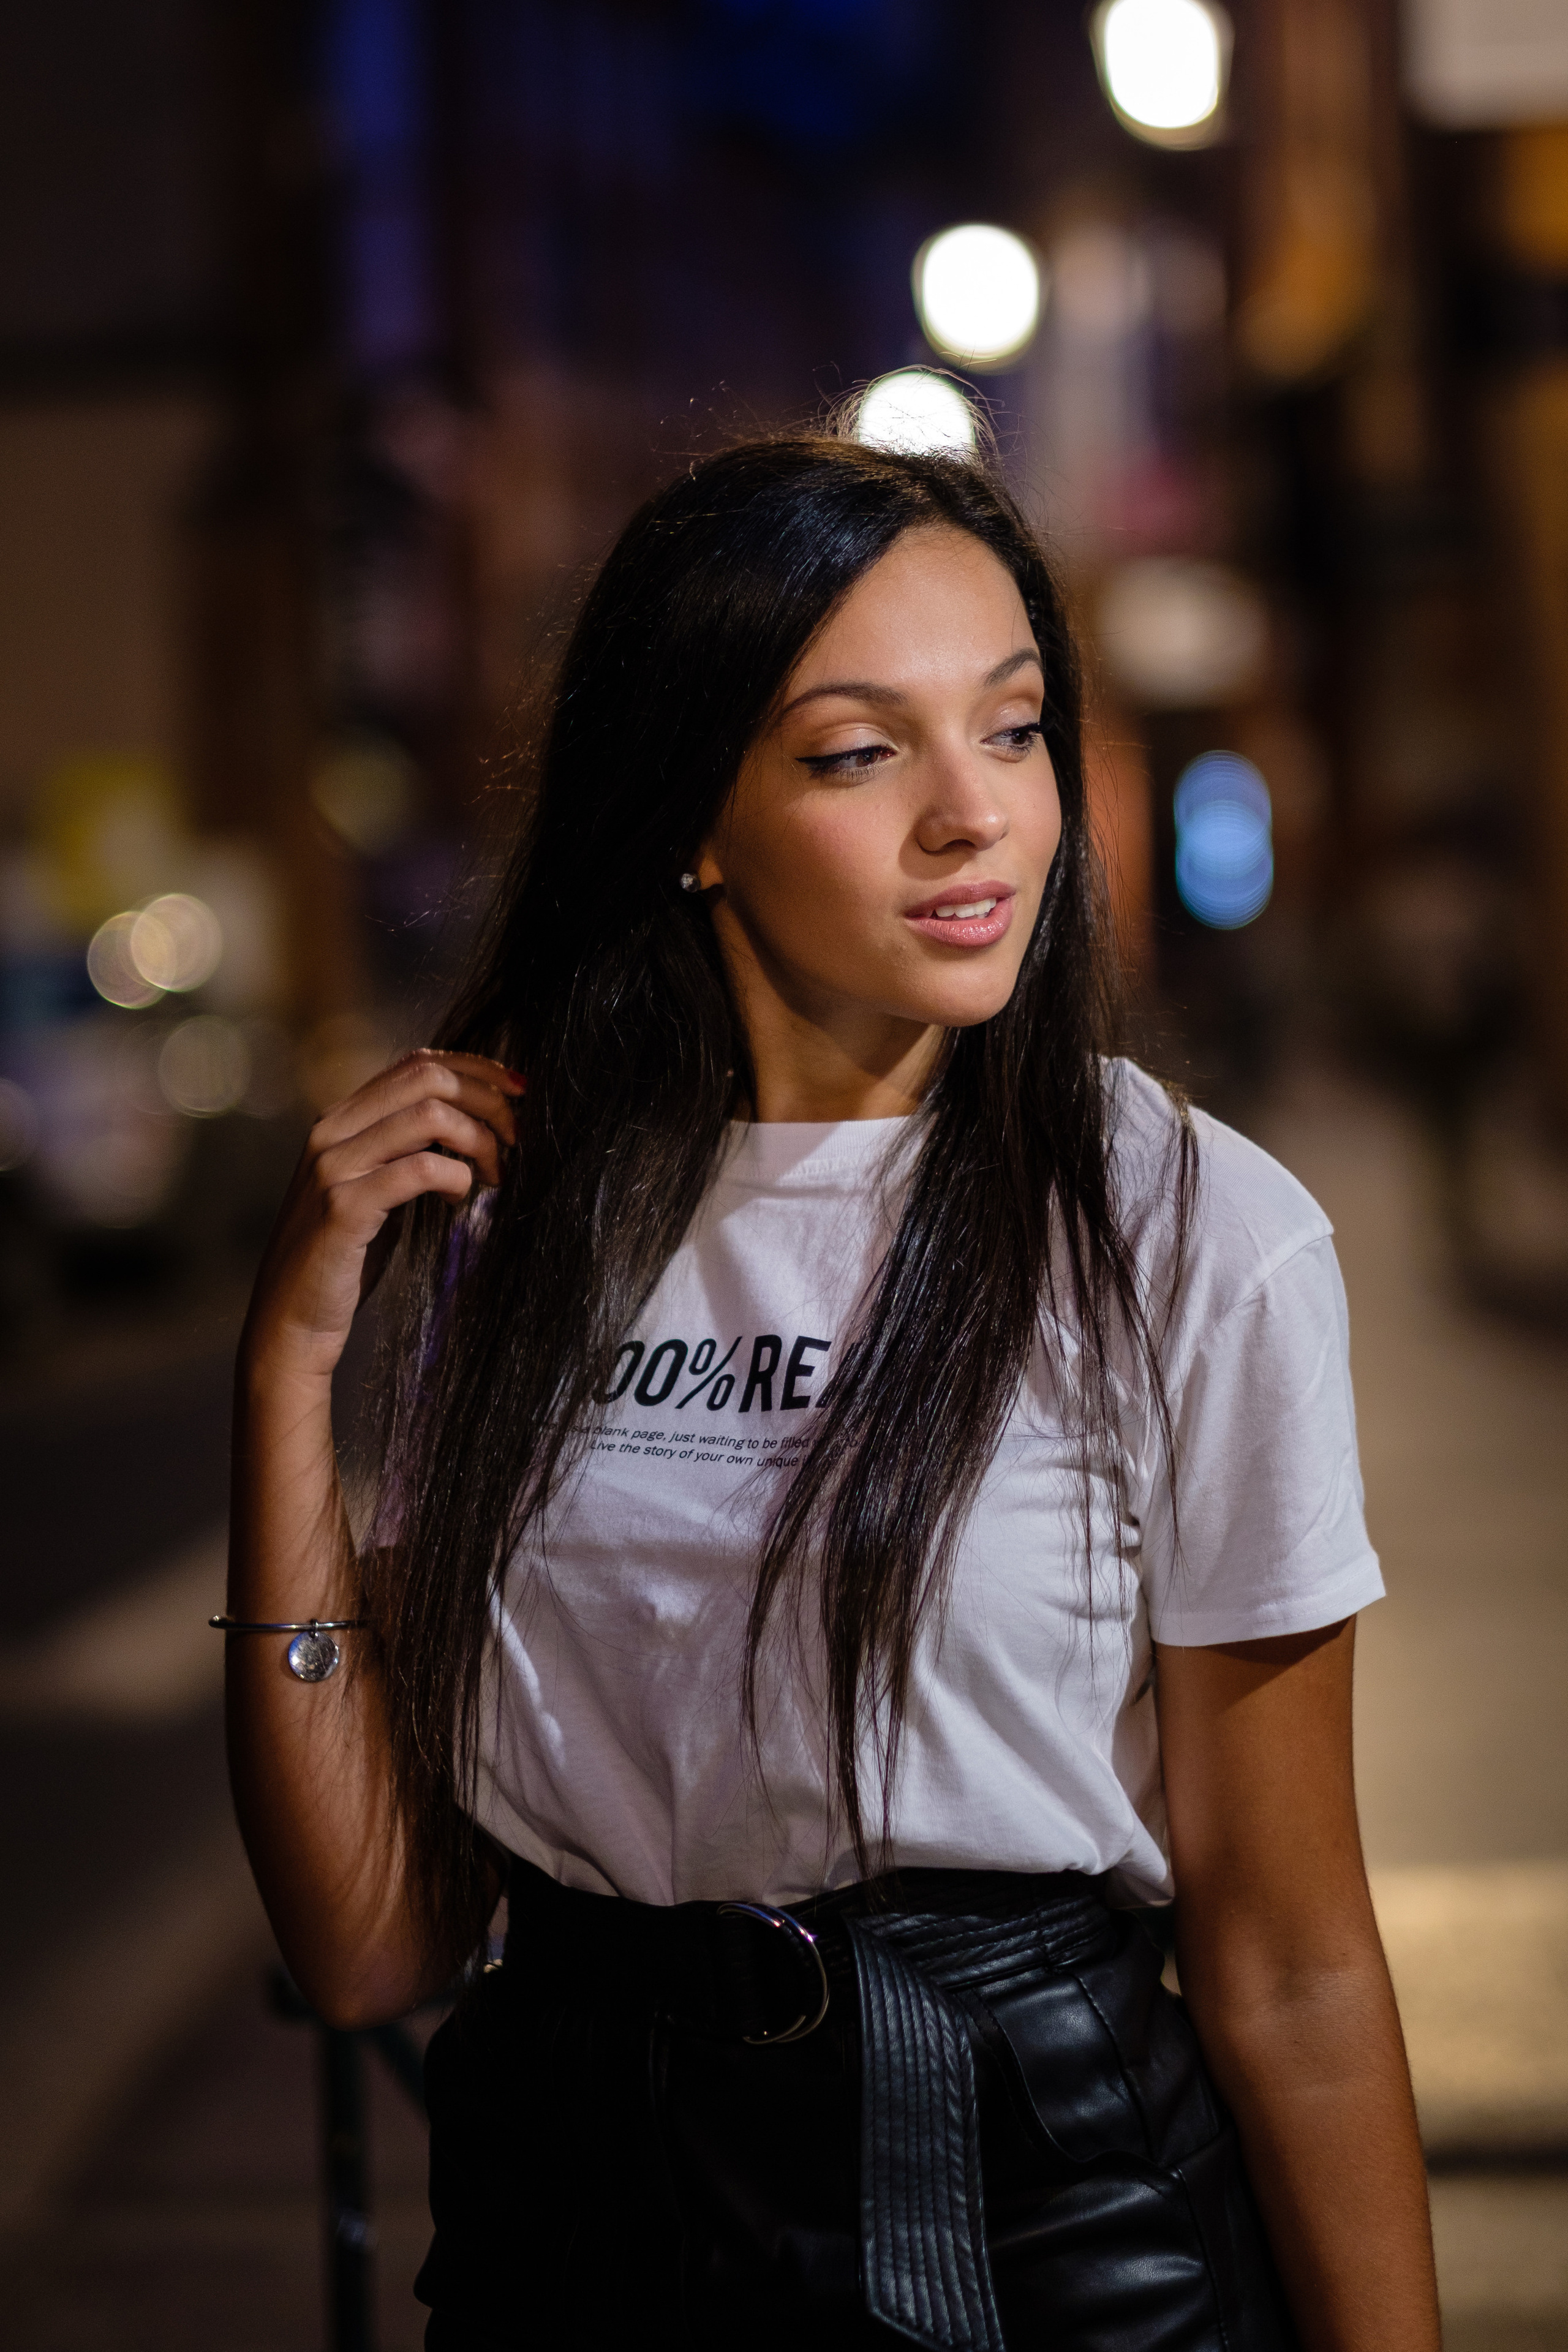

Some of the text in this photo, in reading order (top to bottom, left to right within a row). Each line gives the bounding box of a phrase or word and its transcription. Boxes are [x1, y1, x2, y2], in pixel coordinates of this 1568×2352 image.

[630, 1430, 666, 1441] page,
[668, 1431, 696, 1443] just
[699, 1435, 746, 1450] waiting
[747, 1439, 759, 1449] to
[762, 1438, 777, 1449] be
[780, 1437, 810, 1449] filled
[590, 1439, 616, 1452] Live
[619, 1443, 641, 1453] the
[643, 1446, 677, 1459] story
[679, 1449, 695, 1459] of
[693, 1452, 724, 1463] your
[726, 1455, 753, 1466] own
[757, 1457, 799, 1469] unique
